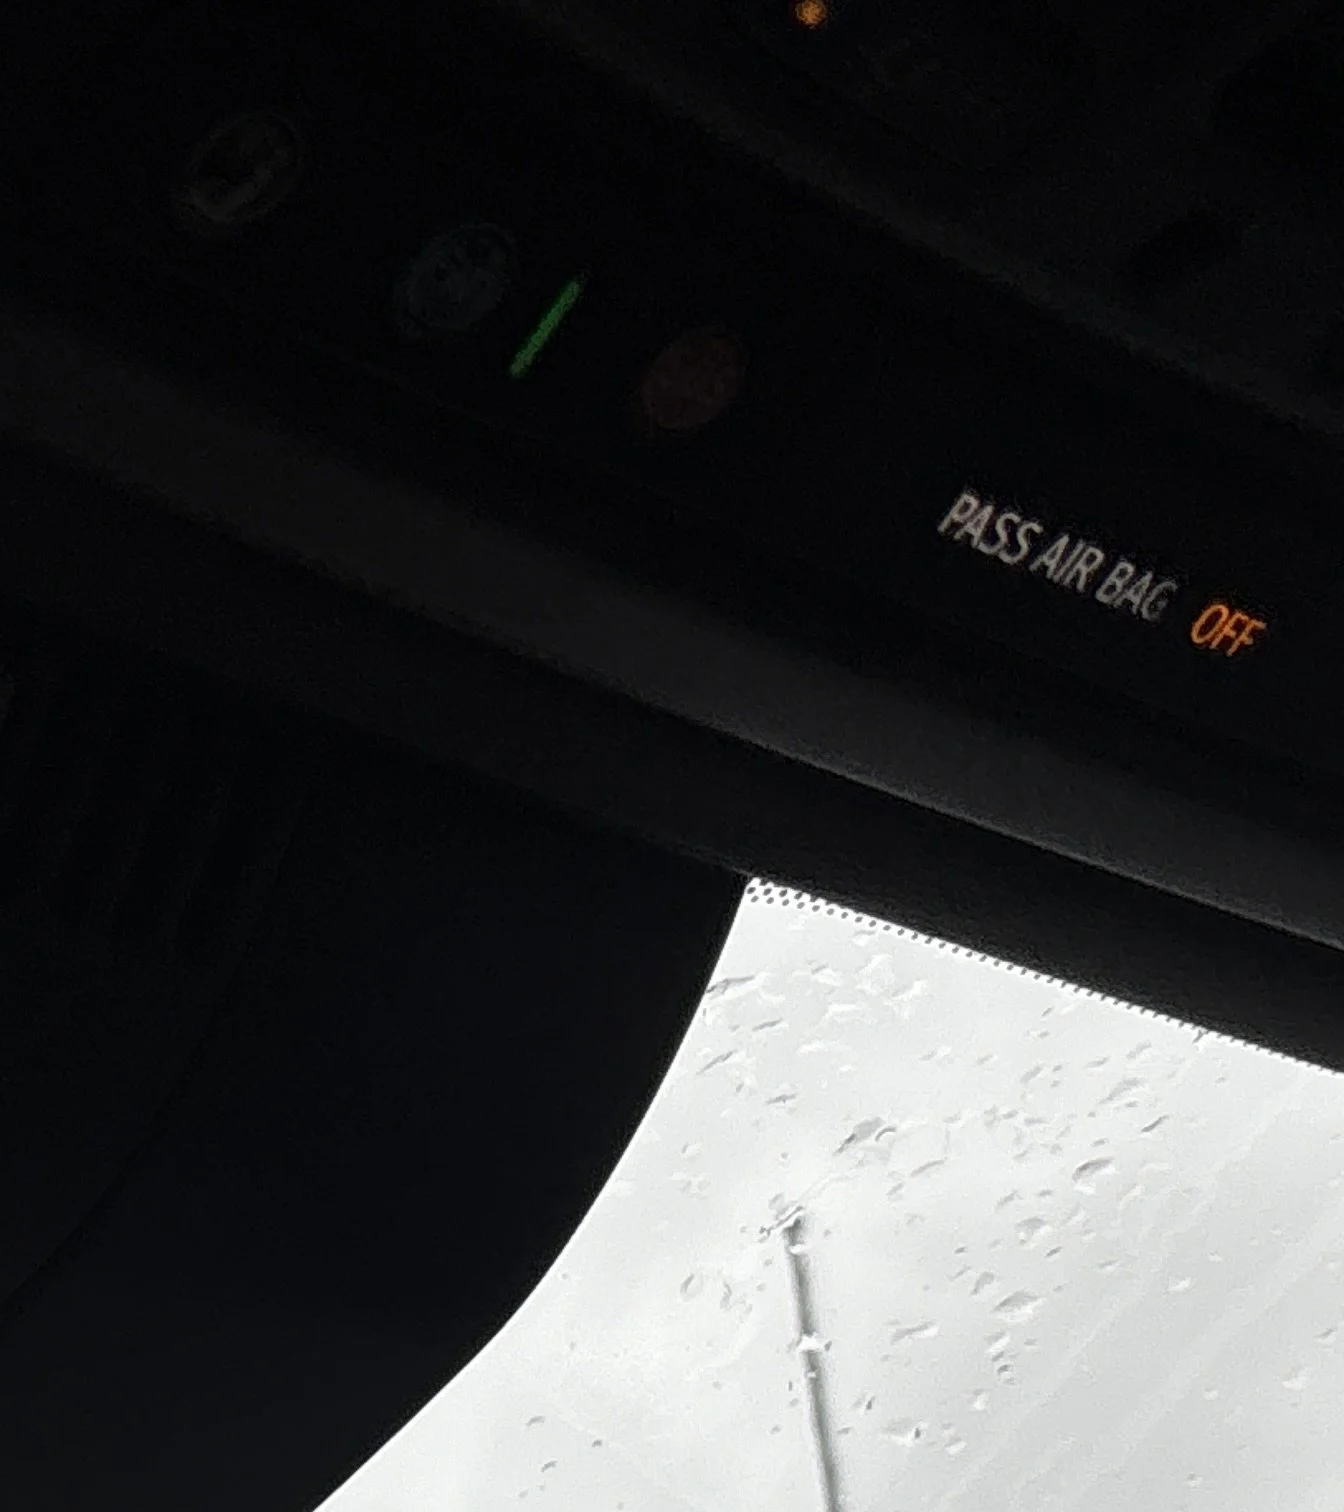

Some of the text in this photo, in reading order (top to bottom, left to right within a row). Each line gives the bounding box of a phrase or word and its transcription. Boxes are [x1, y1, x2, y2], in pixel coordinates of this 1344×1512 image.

[938, 492, 1267, 656] PASS AIR BAG OFF
